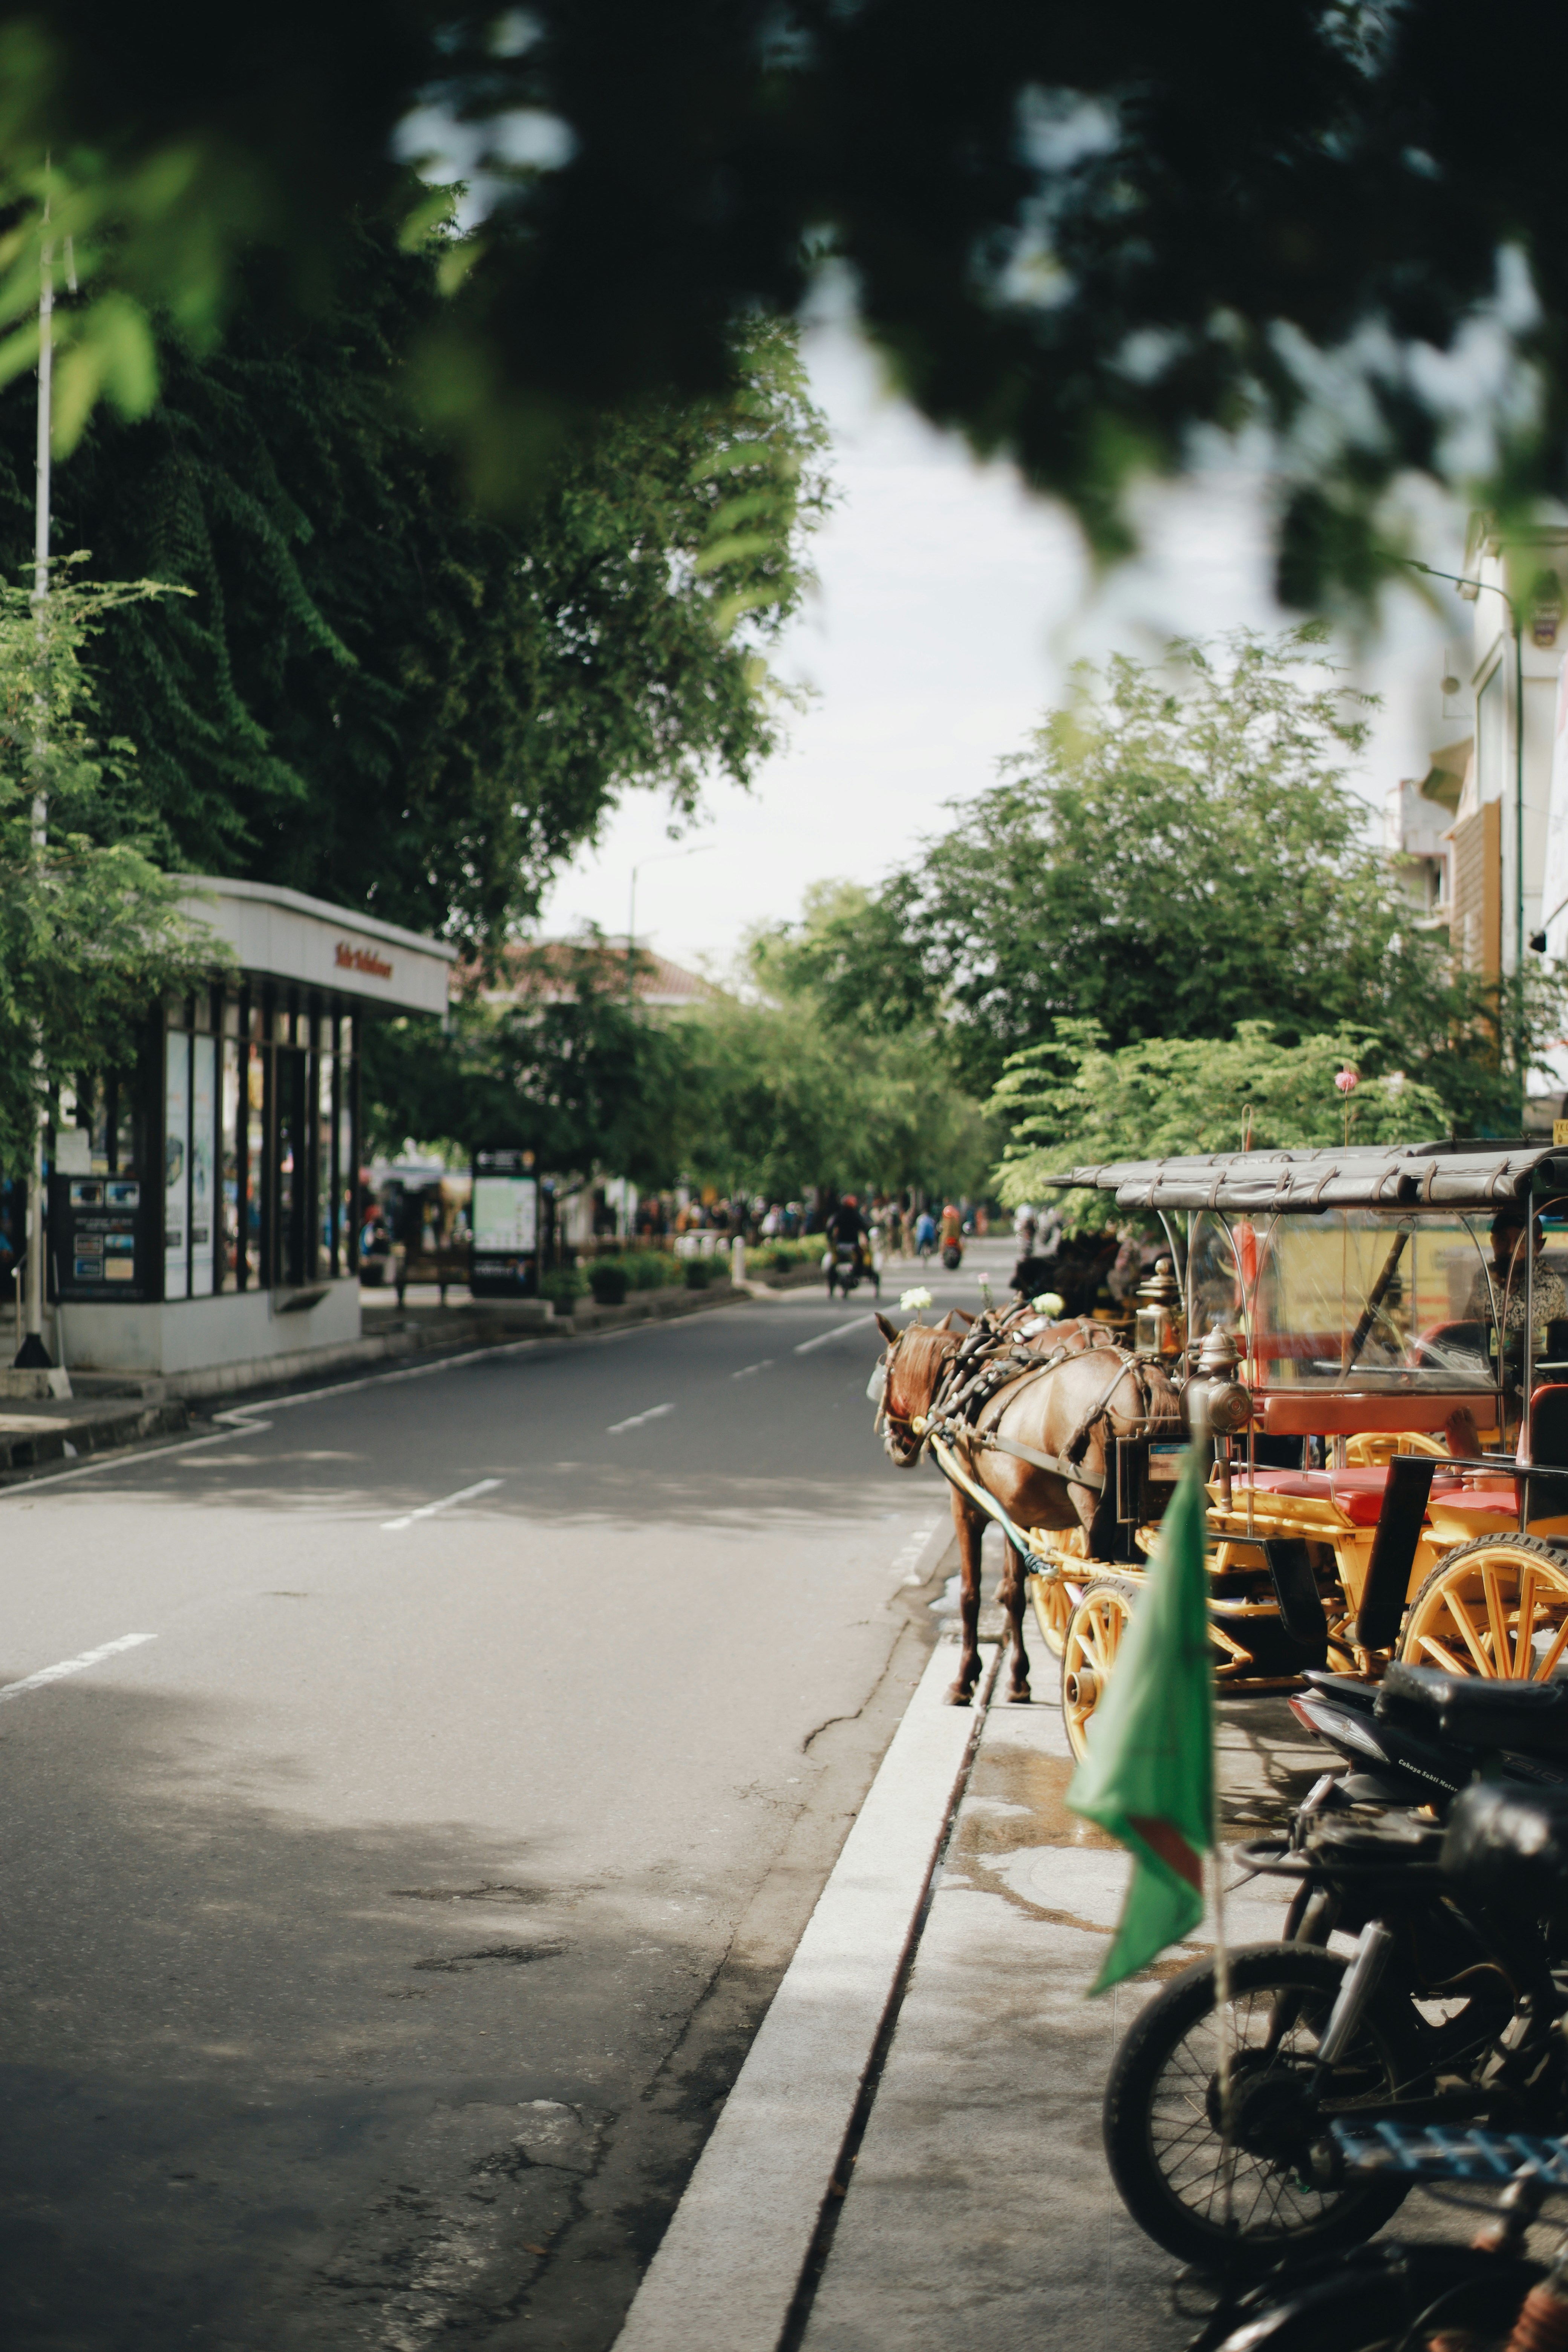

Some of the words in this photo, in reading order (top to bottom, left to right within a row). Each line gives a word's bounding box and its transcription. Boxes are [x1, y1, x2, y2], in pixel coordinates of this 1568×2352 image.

[1398, 1759, 1421, 1774] Cahaya
[1422, 1771, 1439, 1783] Sakti
[1439, 1780, 1458, 1792] Motor
